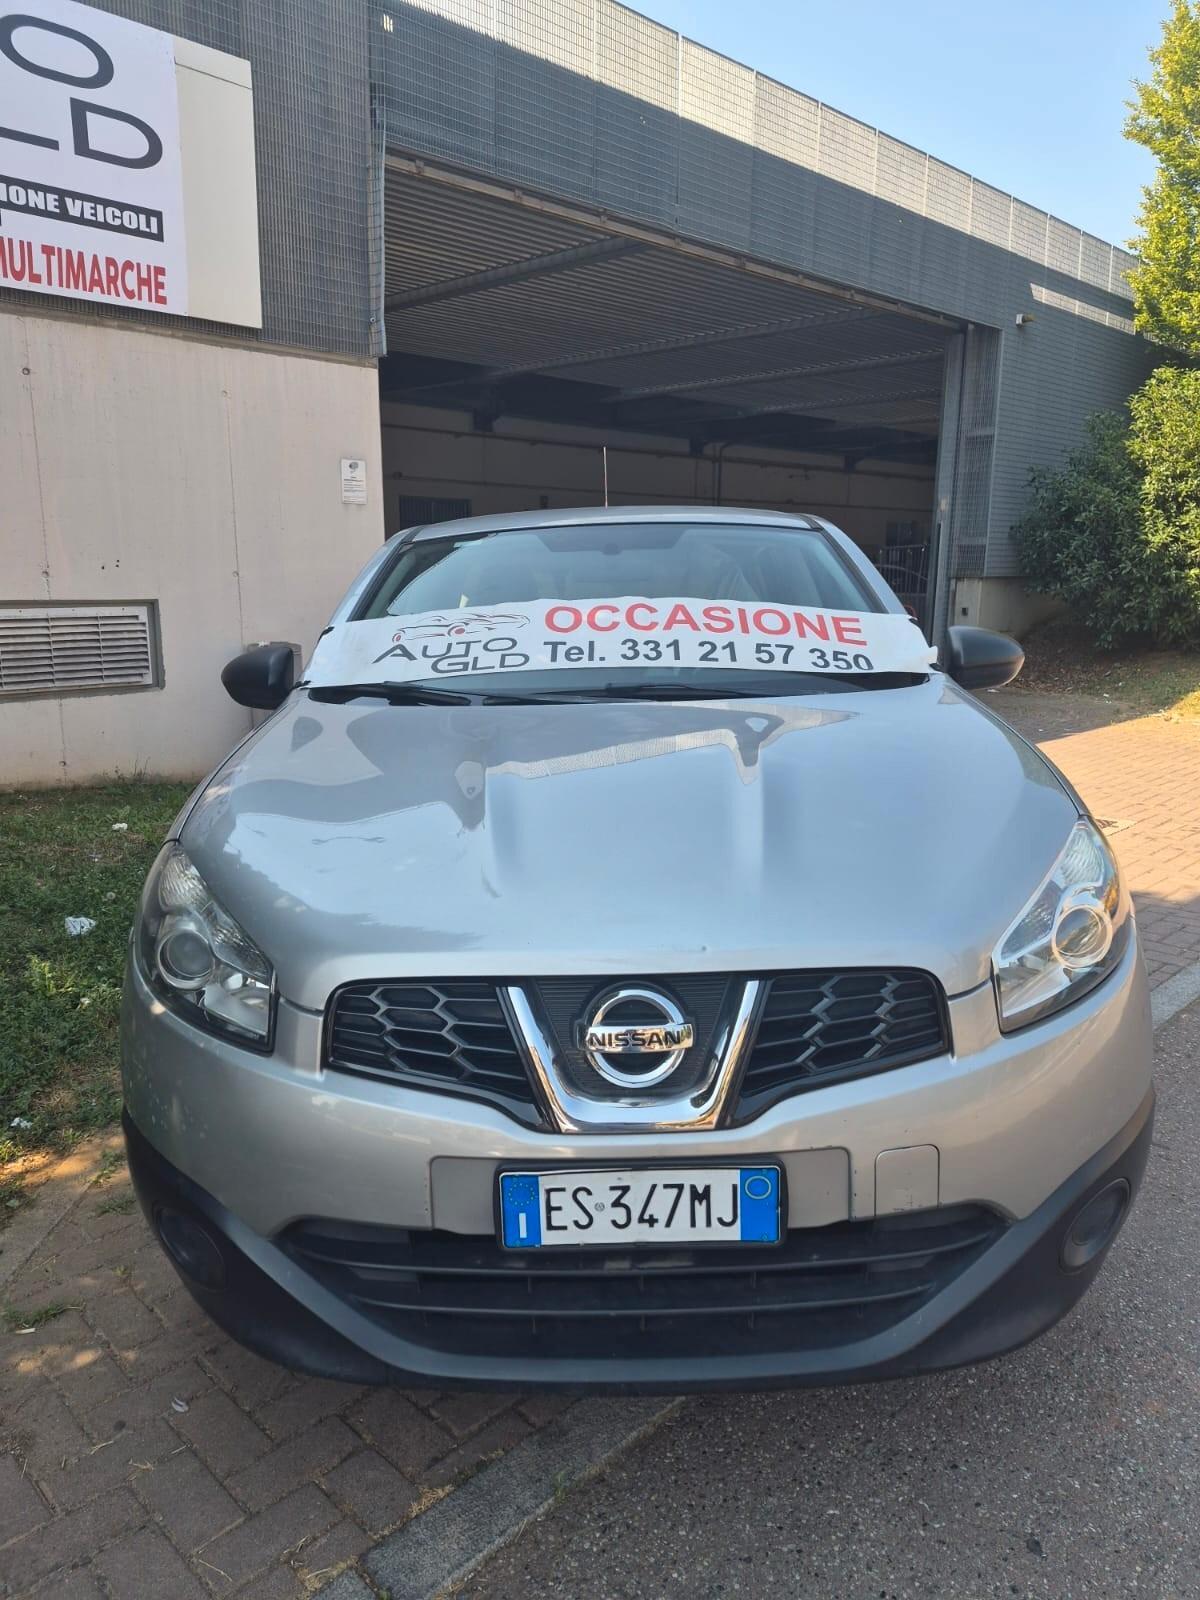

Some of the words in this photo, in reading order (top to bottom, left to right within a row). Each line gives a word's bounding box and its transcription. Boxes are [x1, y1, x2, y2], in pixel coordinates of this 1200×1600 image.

[64, 196, 159, 235] VEICOLI
[544, 603, 867, 646] OCCASIONE
[372, 637, 518, 665] AUTO
[430, 652, 530, 675] GLD
[543, 640, 606, 663] Tel.
[620, 638, 681, 661] 331
[698, 640, 738, 663] 21
[755, 642, 795, 665] 57
[811, 647, 874, 672] 350
[588, 1030, 682, 1047] NISSAN
